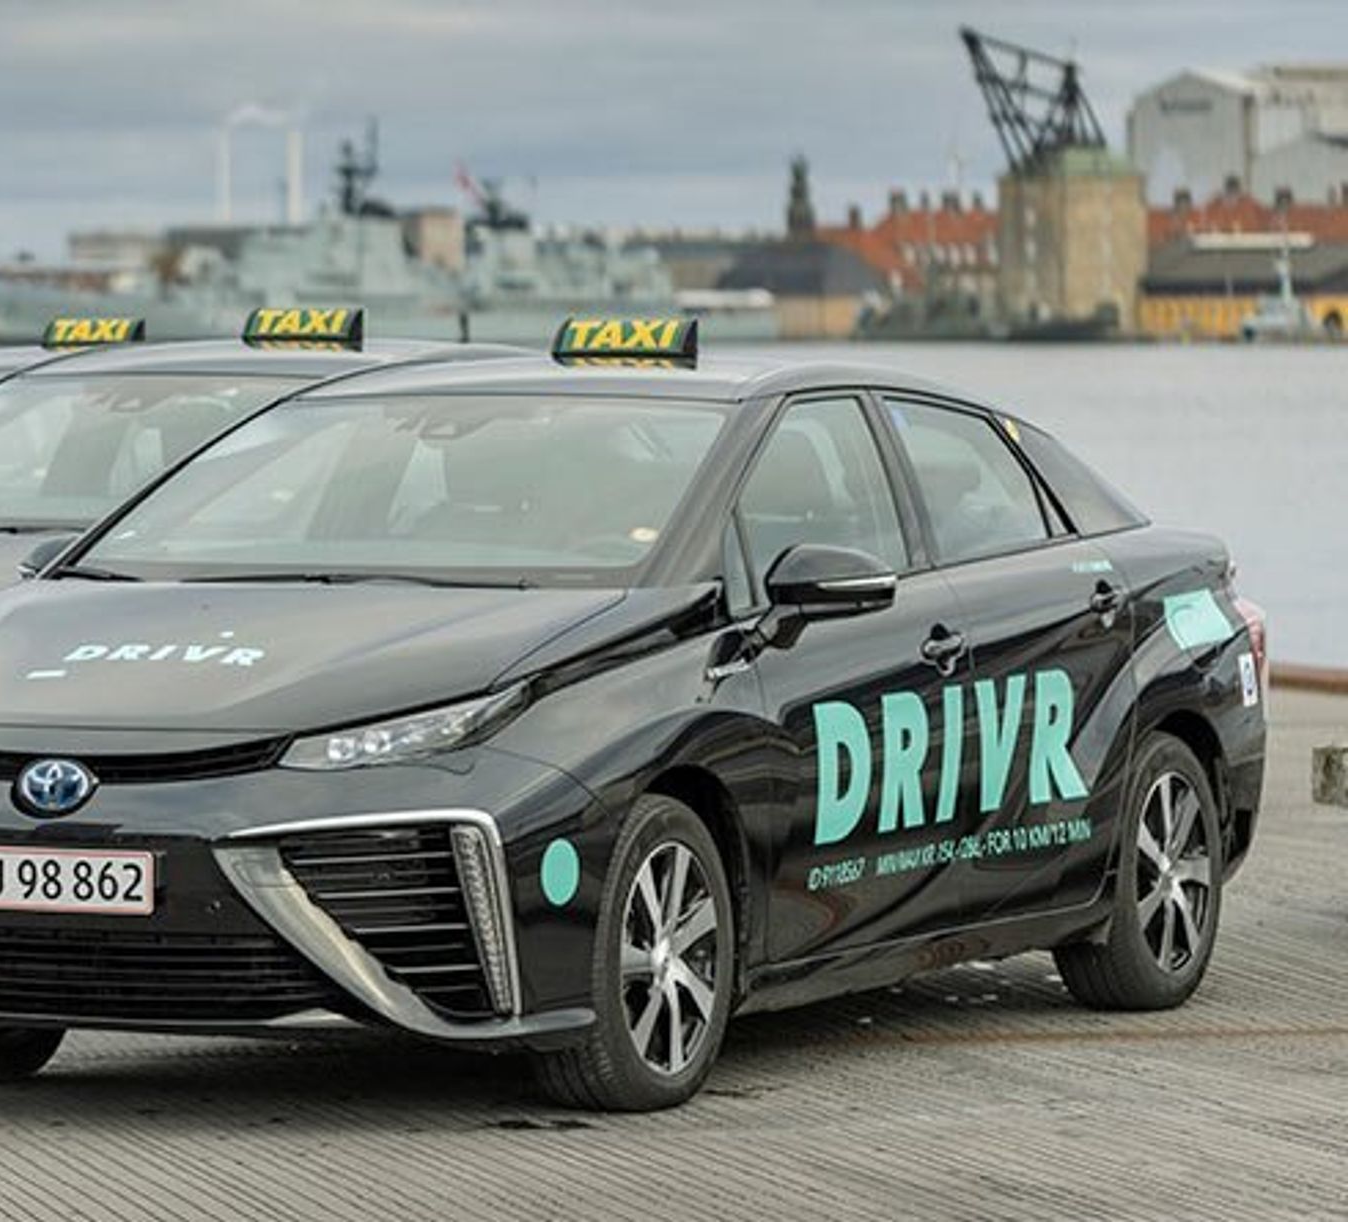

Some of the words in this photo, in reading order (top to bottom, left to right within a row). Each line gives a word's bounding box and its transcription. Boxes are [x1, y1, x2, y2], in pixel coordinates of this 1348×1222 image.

[55, 319, 131, 342] TAXI
[258, 308, 348, 335] TAXI
[568, 319, 680, 349] TAXI
[63, 644, 265, 667] DRIVR
[812, 669, 1090, 846] DRIVR
[987, 829, 1011, 854] FOR
[18, 859, 62, 900] 98
[73, 860, 144, 902] 862
